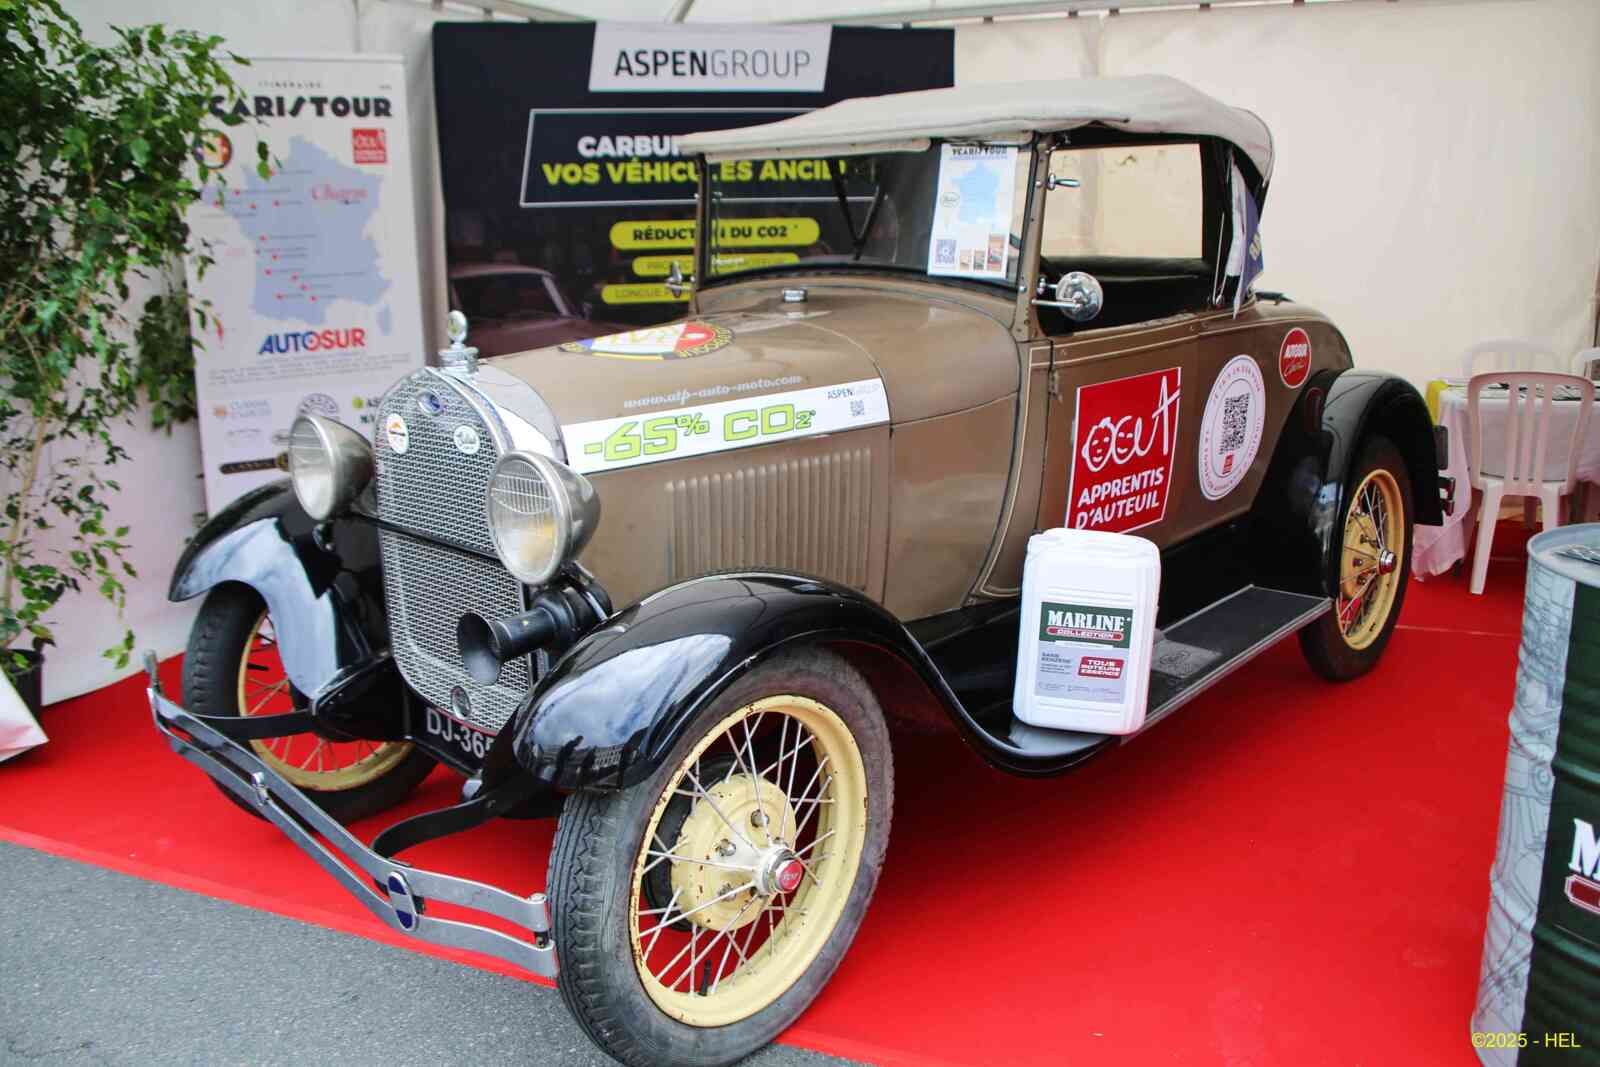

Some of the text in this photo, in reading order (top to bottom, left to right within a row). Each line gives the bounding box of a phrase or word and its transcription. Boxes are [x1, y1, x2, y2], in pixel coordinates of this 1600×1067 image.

[614, 49, 811, 77] ASPENGROUP
[206, 95, 393, 117] CARISTOUR
[542, 162, 601, 184] VOS
[606, 157, 752, 184] VÉHICUES
[730, 226, 752, 238] DU
[756, 225, 788, 238] CO2
[257, 328, 366, 355] AUTOSUR
[583, 411, 710, 462] -65%
[1077, 466, 1165, 508] APPRENTIS
[1075, 491, 1160, 530] D'AUTEUIL
[1047, 609, 1125, 632] MARLINE
